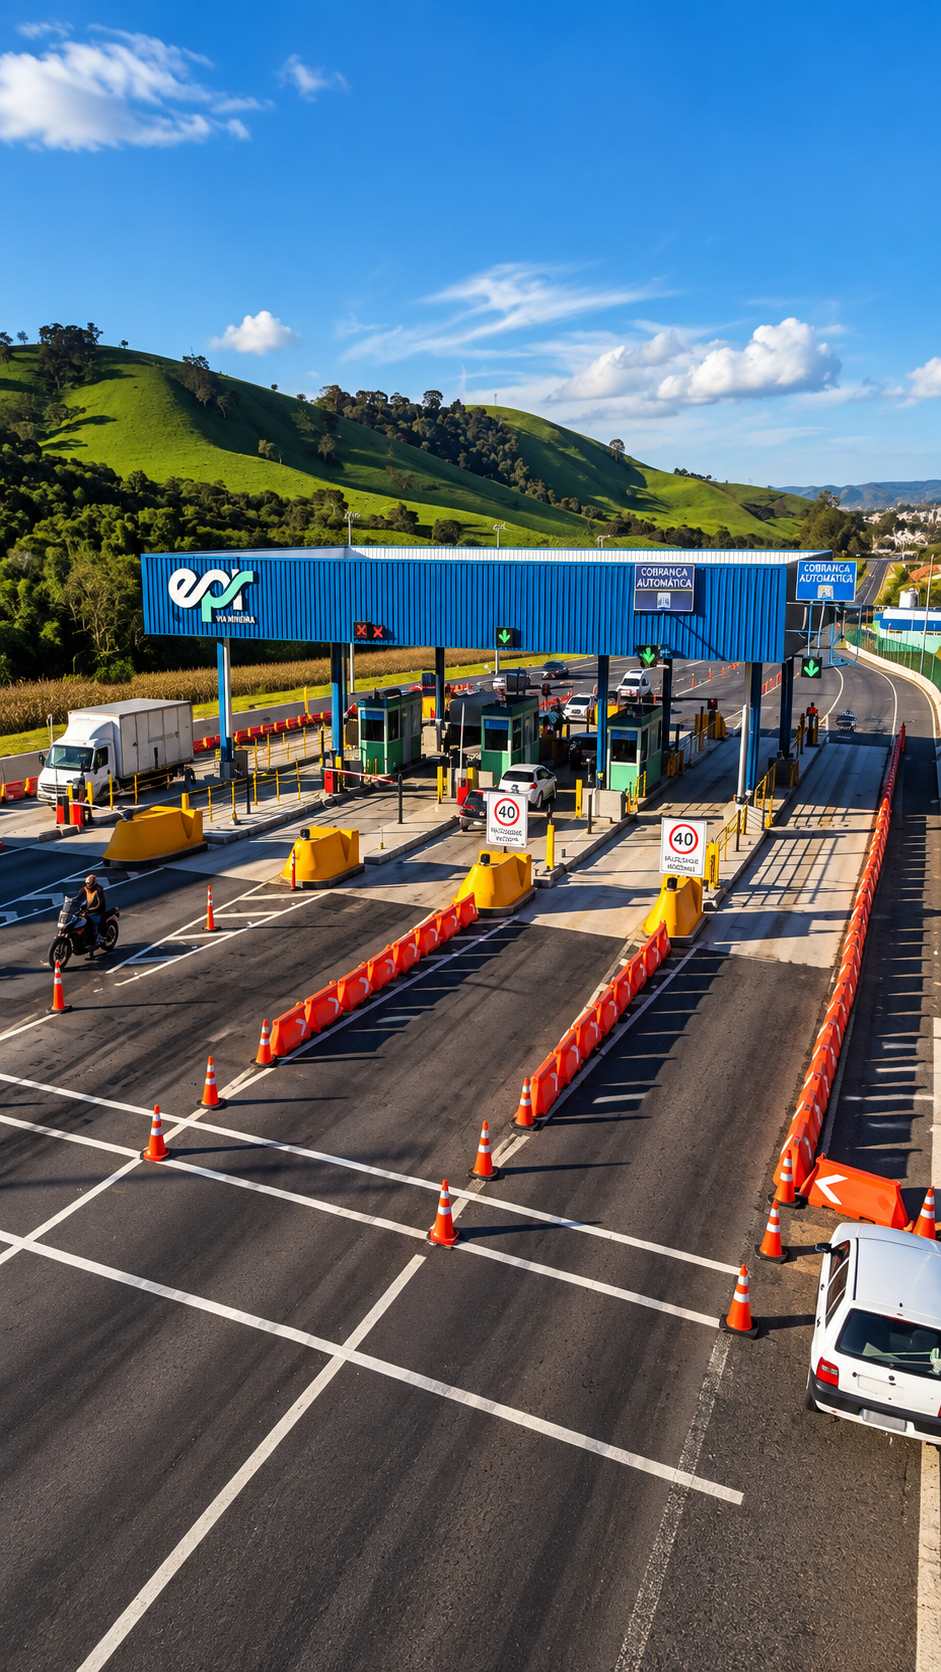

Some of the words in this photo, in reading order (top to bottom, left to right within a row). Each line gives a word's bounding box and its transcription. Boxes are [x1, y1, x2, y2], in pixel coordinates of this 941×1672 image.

[641, 567, 688, 577] COBRANÇA
[168, 568, 254, 623] epr
[499, 806, 515, 818] 40
[674, 833, 693, 845] 40
